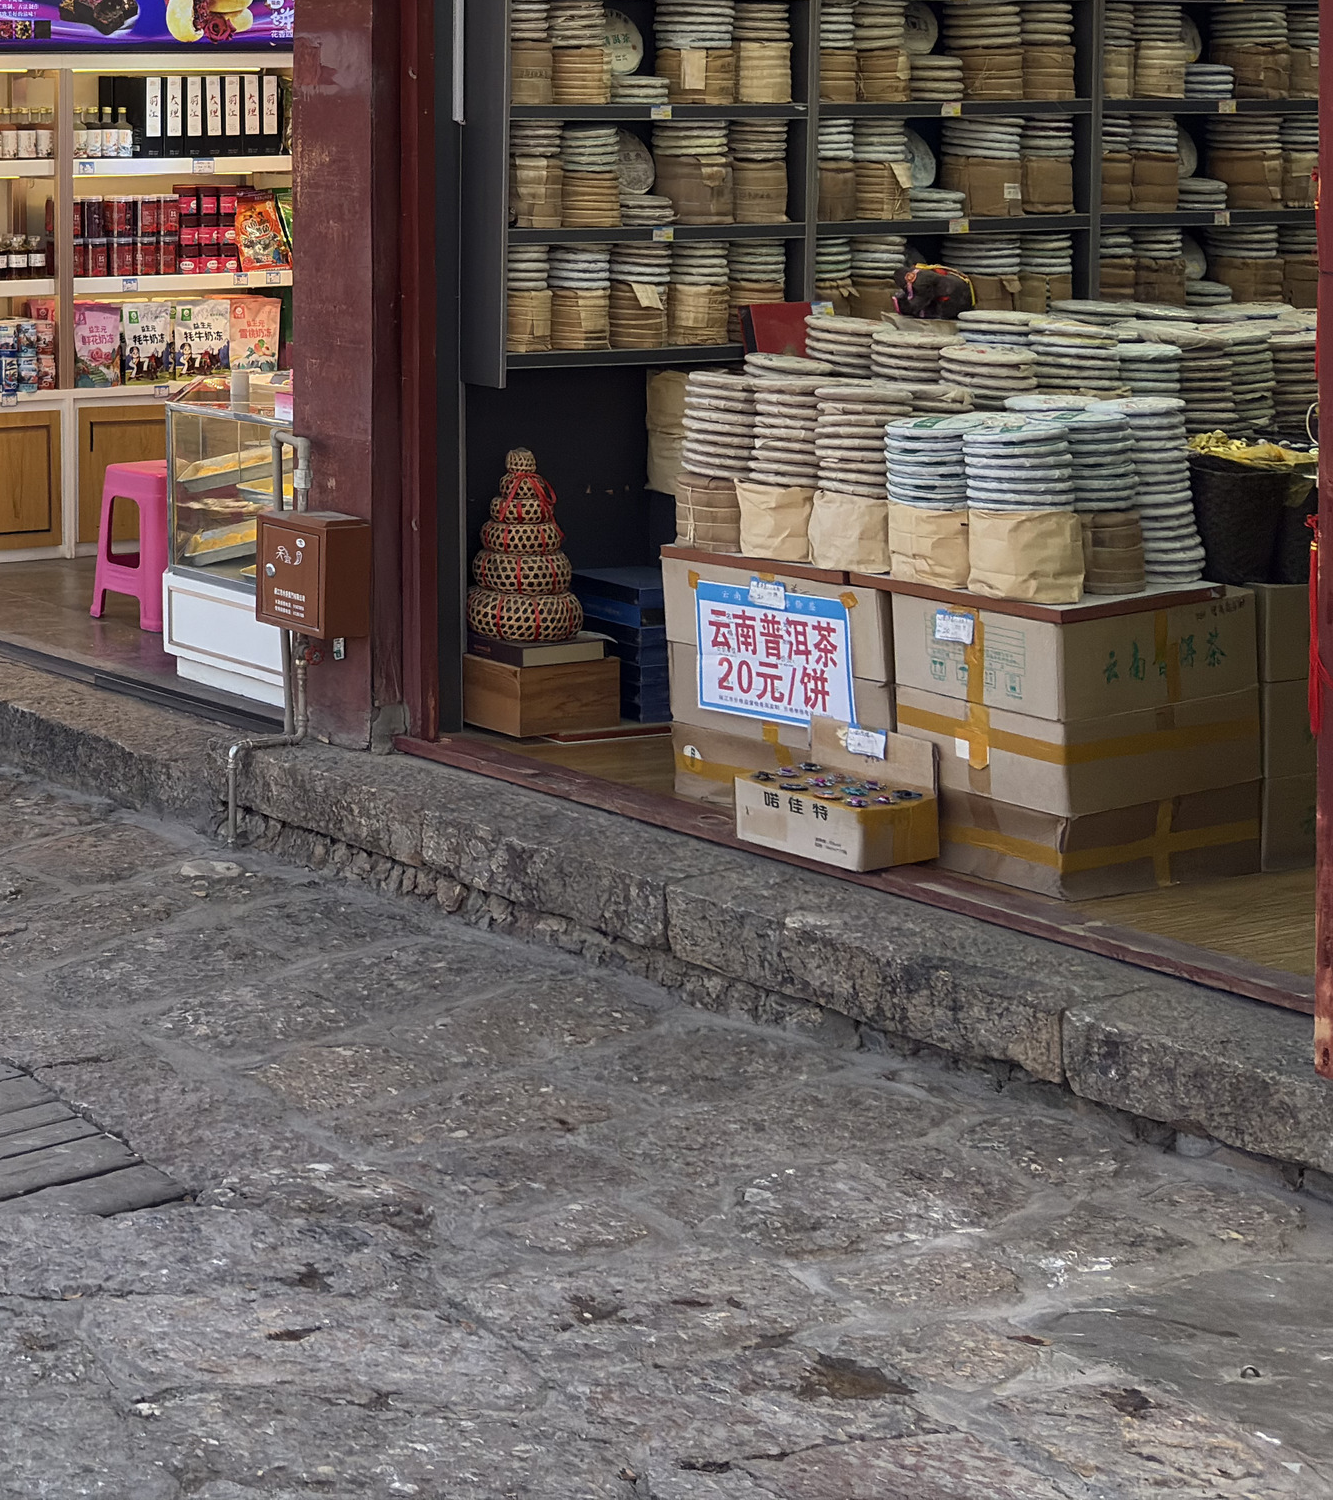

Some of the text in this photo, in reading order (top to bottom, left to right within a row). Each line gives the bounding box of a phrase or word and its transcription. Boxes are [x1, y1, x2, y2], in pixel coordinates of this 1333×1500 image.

[708, 608, 838, 669] 云南普洱茶
[1102, 626, 1228, 685] 云南洱茶
[718, 657, 830, 713] 20元/饼
